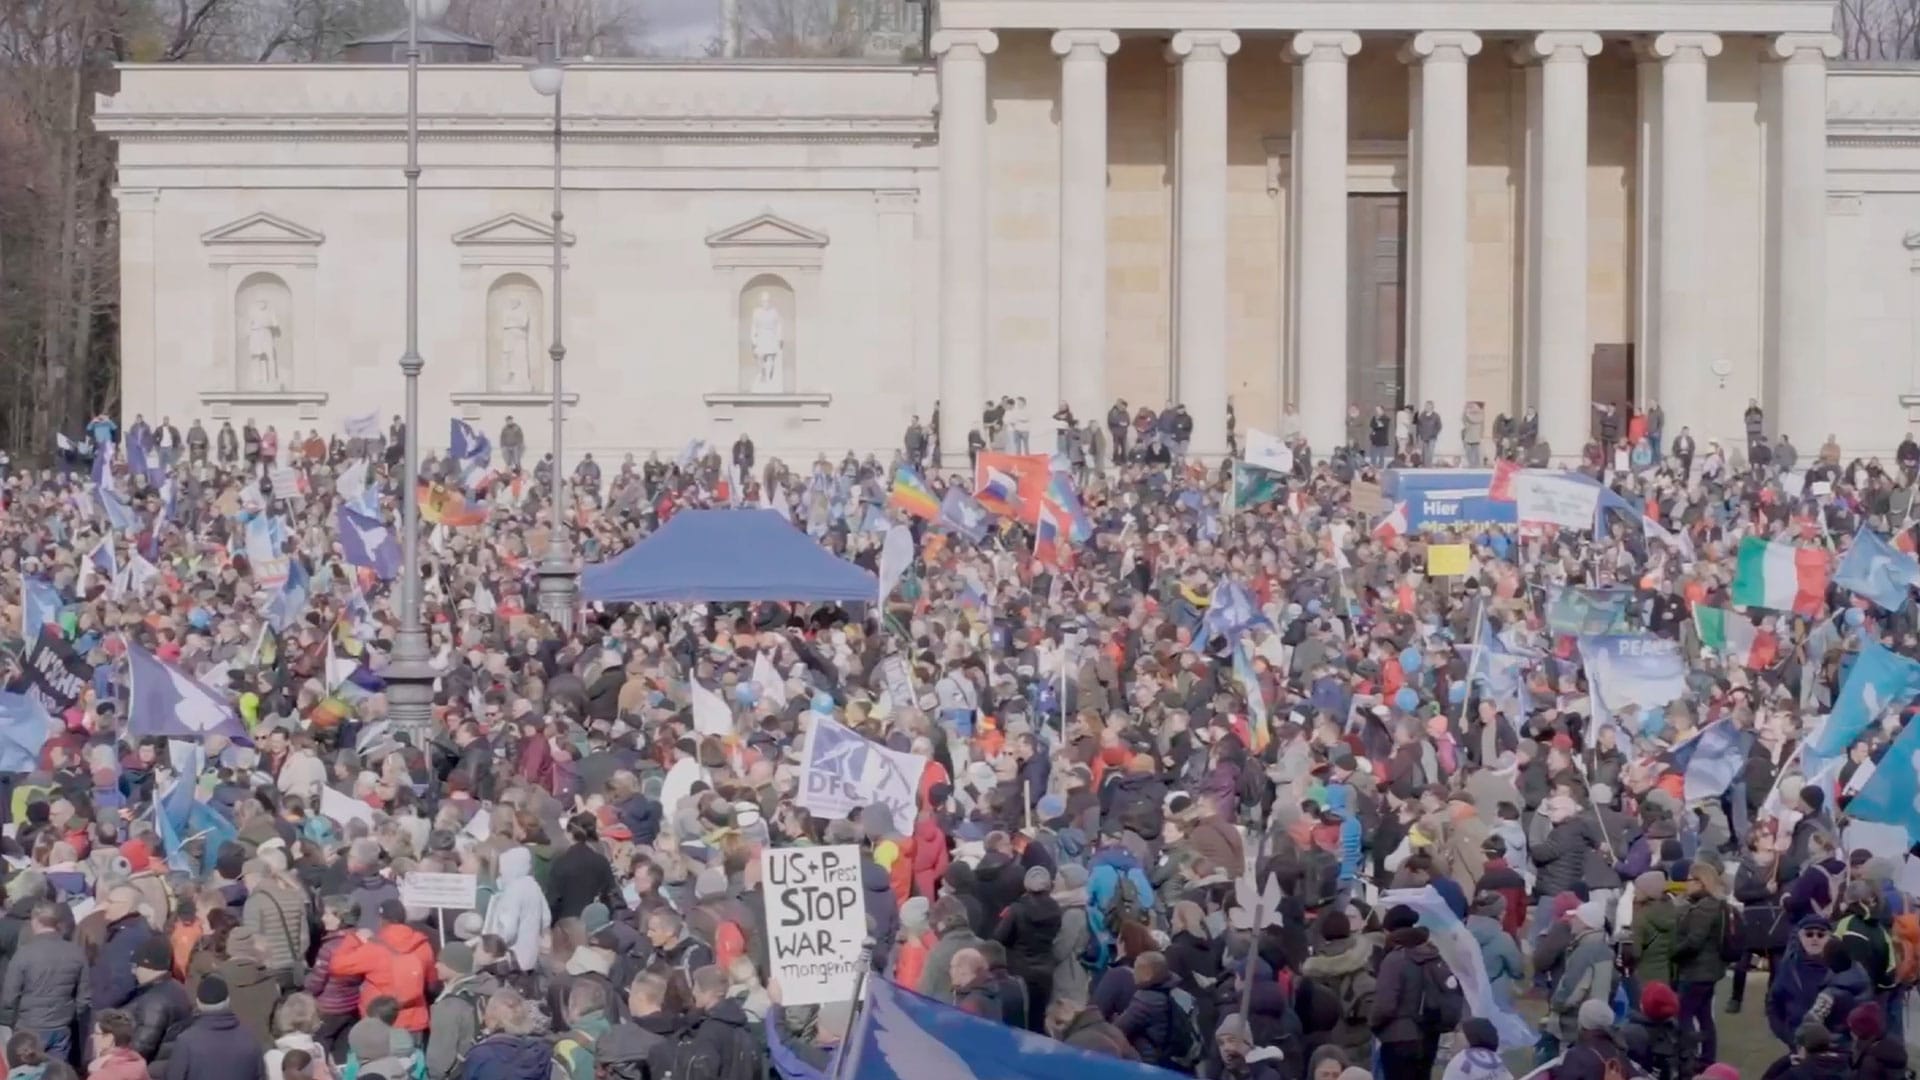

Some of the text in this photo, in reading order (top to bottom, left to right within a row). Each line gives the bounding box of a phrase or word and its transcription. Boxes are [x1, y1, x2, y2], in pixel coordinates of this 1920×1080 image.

[1423, 501, 1458, 515] Hier
[1619, 639, 1675, 656] PEA
[780, 886, 856, 926] STOP
[781, 954, 854, 984] mongerin
